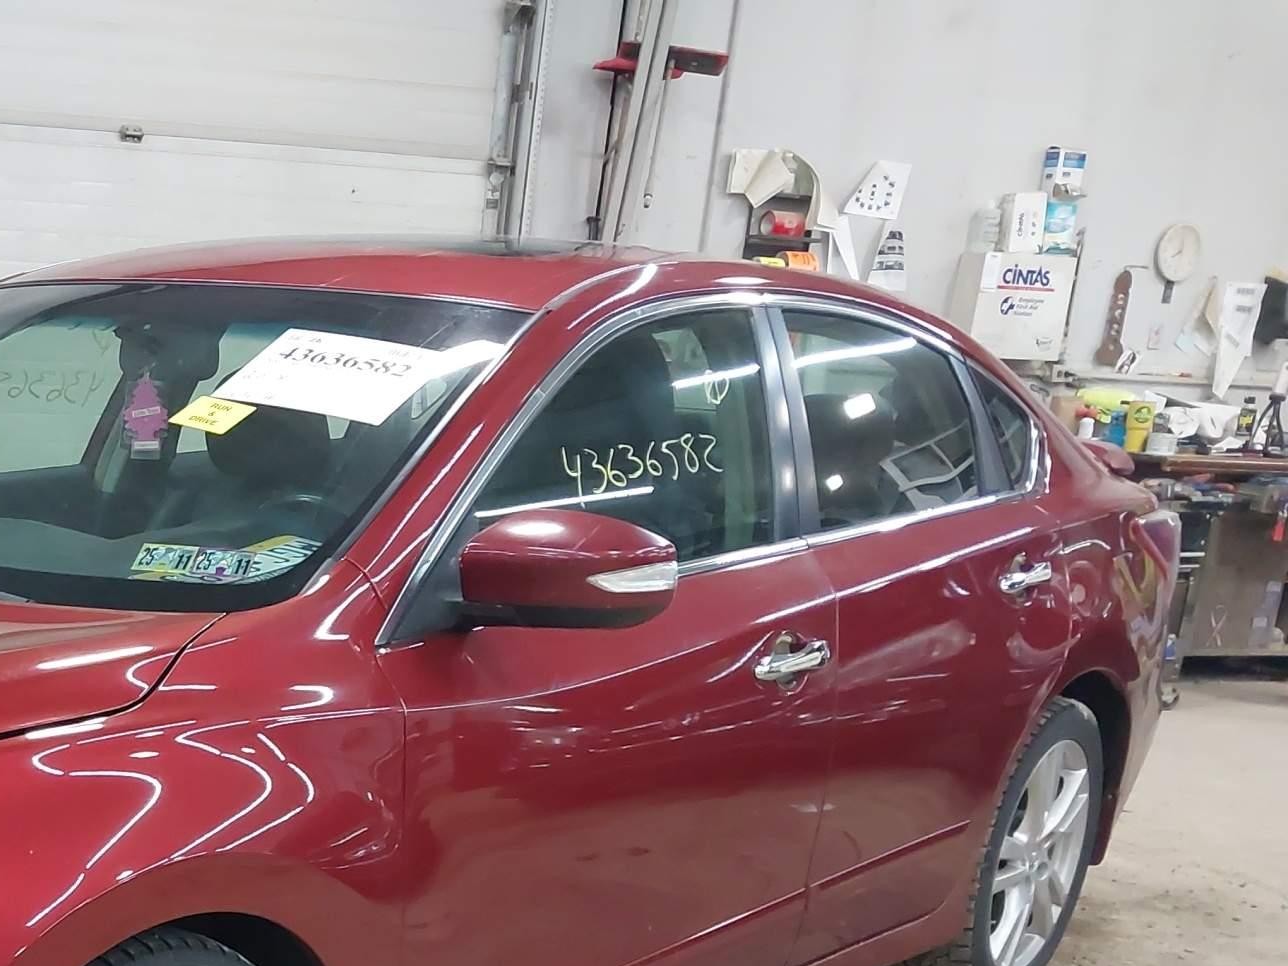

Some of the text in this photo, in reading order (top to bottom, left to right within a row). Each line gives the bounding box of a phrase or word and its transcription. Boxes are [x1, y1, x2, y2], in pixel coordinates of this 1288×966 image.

[1002, 264, 1051, 287] CINTAS
[279, 347, 412, 377] 43636582
[210, 402, 233, 412] RUN
[188, 415, 219, 426] DRIVE
[562, 433, 724, 508] 43636582
[138, 547, 160, 566] 25
[196, 551, 216, 570] 25
